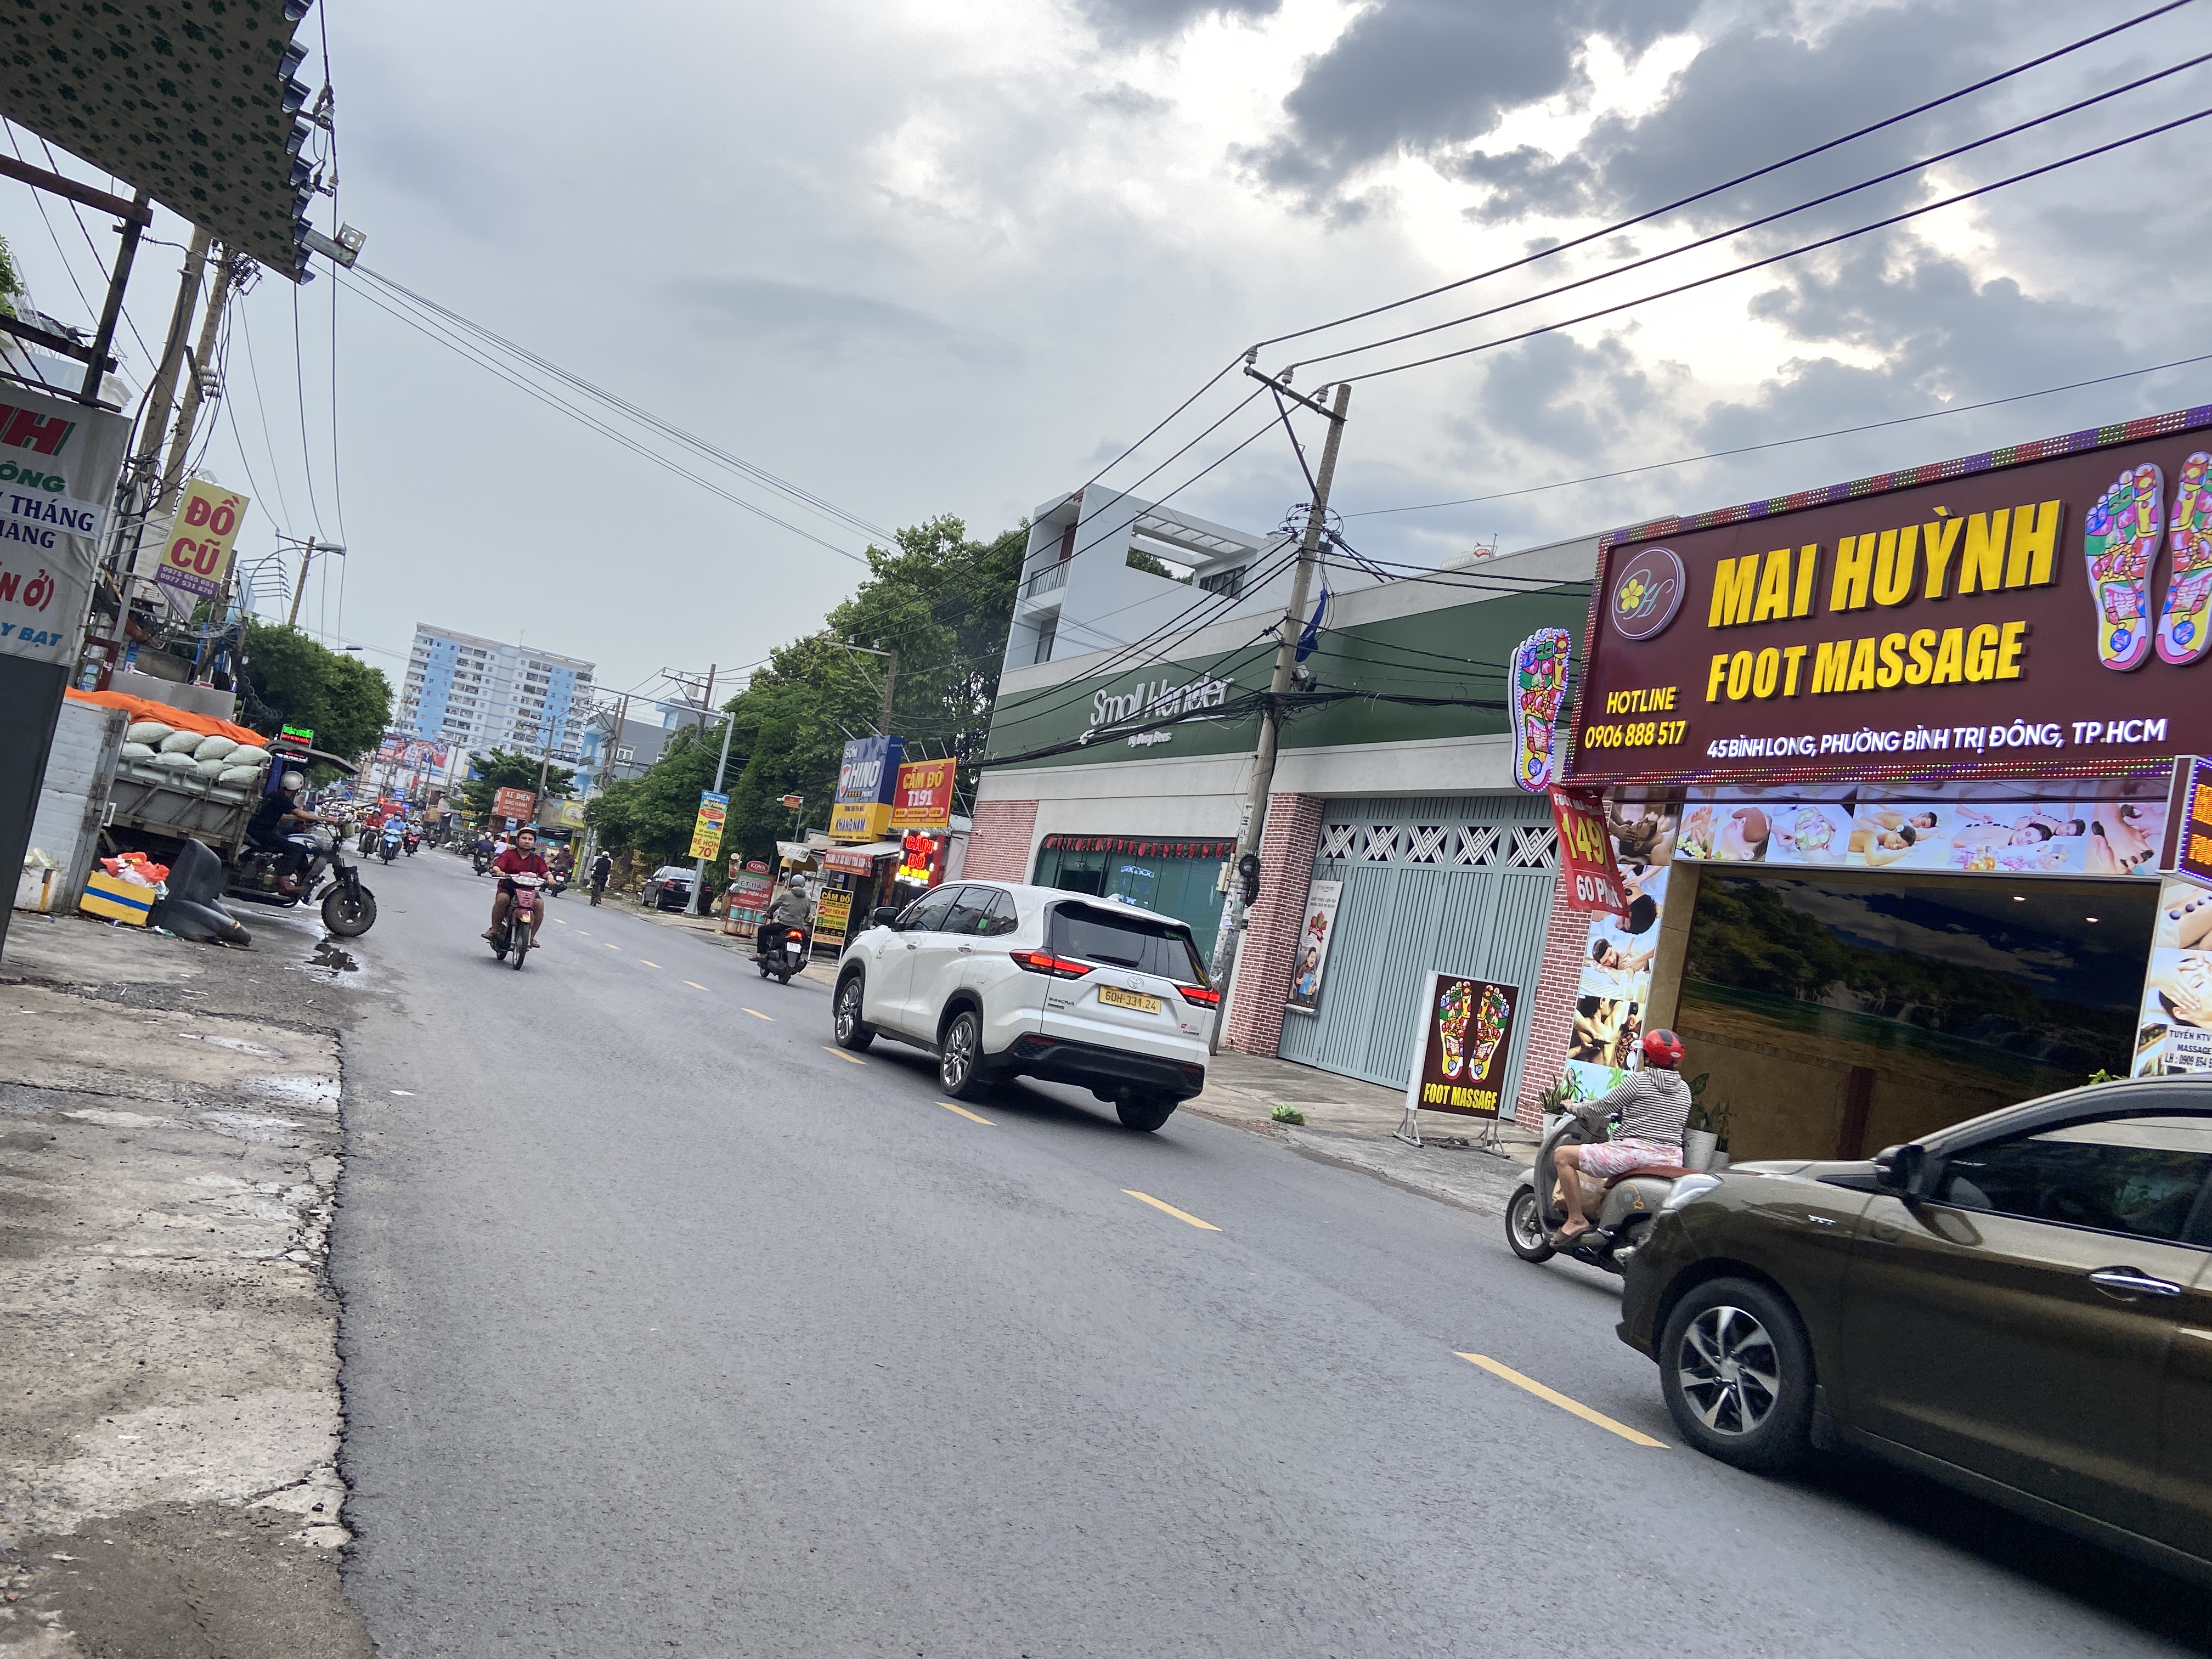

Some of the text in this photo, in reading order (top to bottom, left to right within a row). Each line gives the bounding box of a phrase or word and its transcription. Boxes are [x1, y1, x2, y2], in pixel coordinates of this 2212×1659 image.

[0, 403, 76, 455] H
[9, 494, 94, 532] THÁNG
[184, 495, 240, 536] ĐỒ
[171, 537, 221, 575] CŨ
[1707, 499, 2063, 628] MAI HUỲNH
[160, 573, 212, 595] 0977 531 870
[18, 627, 64, 648] BẠT
[1706, 620, 2029, 703] FOOT MASSAGE
[1090, 672, 1234, 726] Small Wonder
[1606, 686, 1679, 714] HOTLINE
[1137, 733, 1154, 747] Busy
[1153, 731, 1172, 743] Bees
[1584, 720, 1688, 749] 0906 888 517
[1728, 734, 1766, 757] BÌNH
[1766, 735, 1818, 757] LONG,
[1820, 727, 1903, 754] PHƯỜNG
[1903, 725, 1950, 751] BÌNH
[1953, 726, 1987, 755] TRỊ
[1989, 718, 2066, 748] ĐÔNG,
[2072, 718, 2169, 744] TP.HCM
[848, 760, 881, 789] HINO
[908, 789, 933, 806] T191
[1553, 793, 1573, 808] FOOT
[834, 818, 866, 832] KHANG NAM
[703, 839, 719, 849] HƠN
[750, 862, 766, 871] KOVA
[740, 881, 762, 890] CT-11A
[821, 890, 839, 901] CẦM
[1576, 874, 1594, 901] 60
[1048, 997, 1075, 1006] INNOVA
[2170, 1029, 2212, 1042] TUYỂN KTV
[2177, 1044, 2212, 1055] MASSAGE
[1423, 1083, 1498, 1111] FOOT MASSAGE
